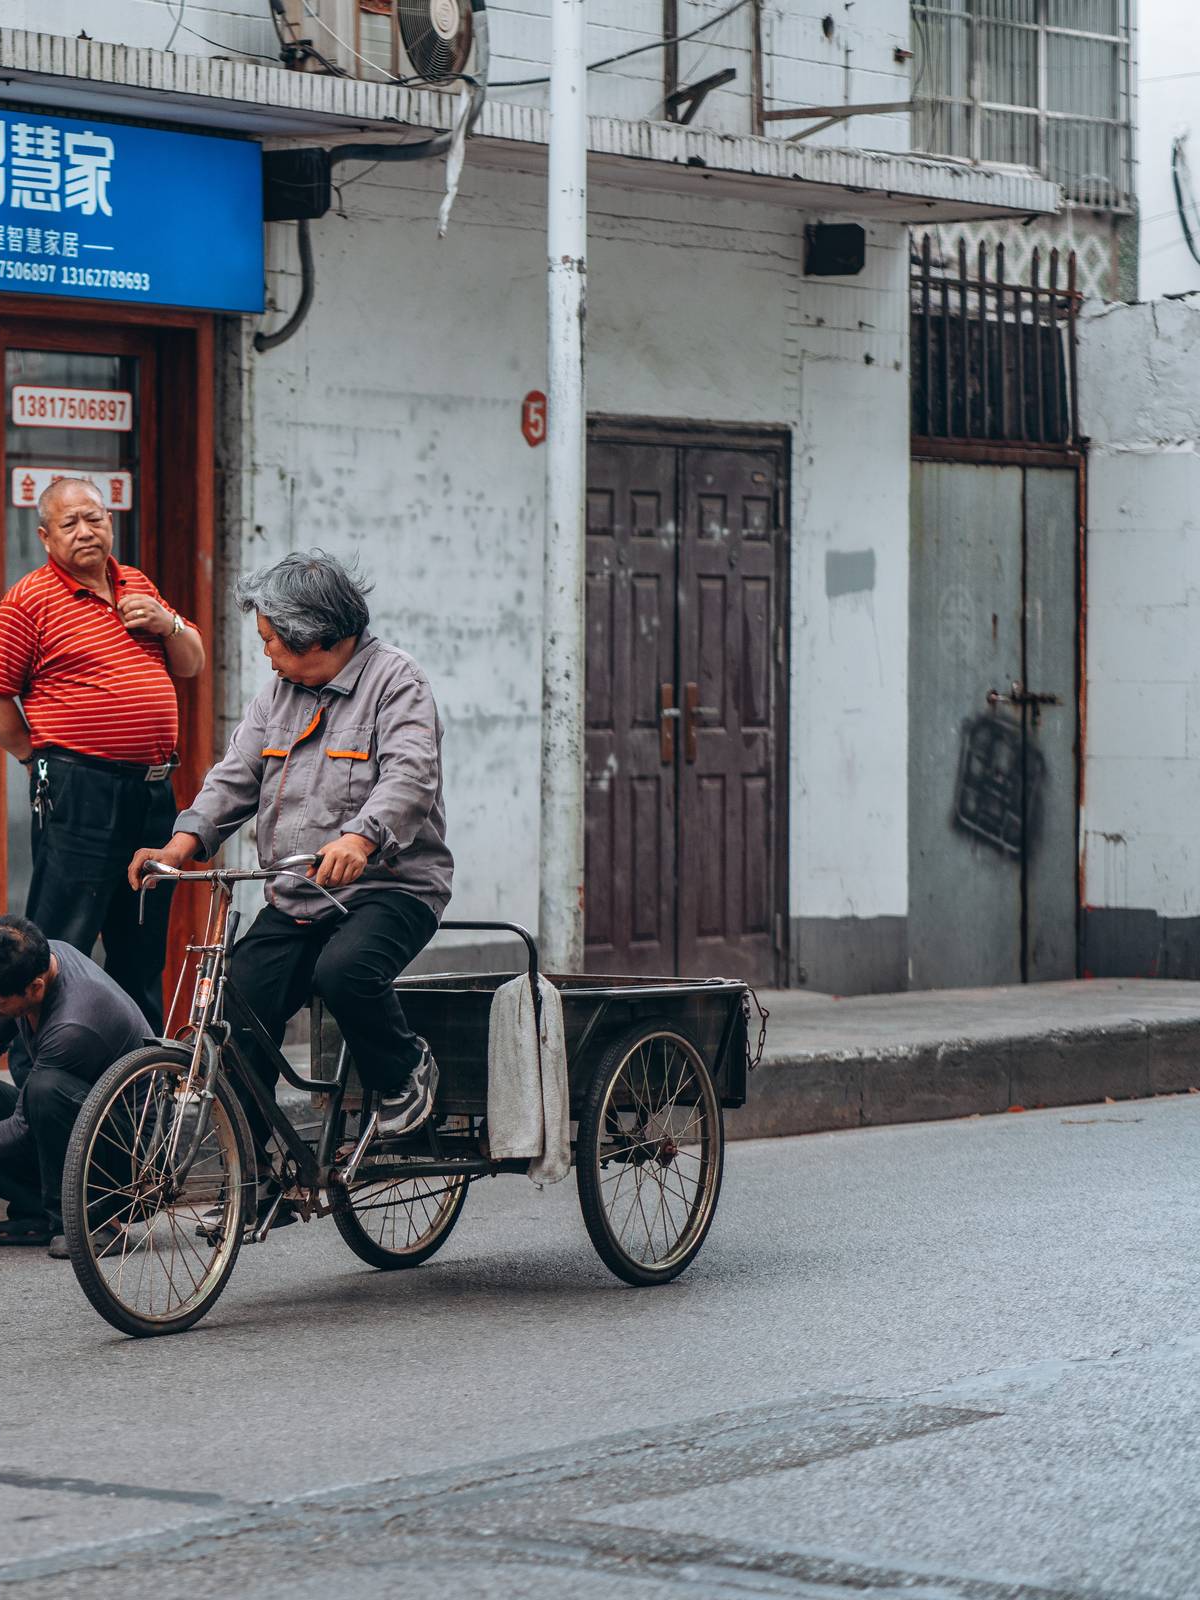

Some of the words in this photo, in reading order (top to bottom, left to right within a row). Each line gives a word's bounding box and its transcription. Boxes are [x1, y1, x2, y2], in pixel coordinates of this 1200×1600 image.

[61, 266, 150, 292] 13162789693
[18, 395, 126, 423] 13817506897
[529, 400, 544, 438] 5
